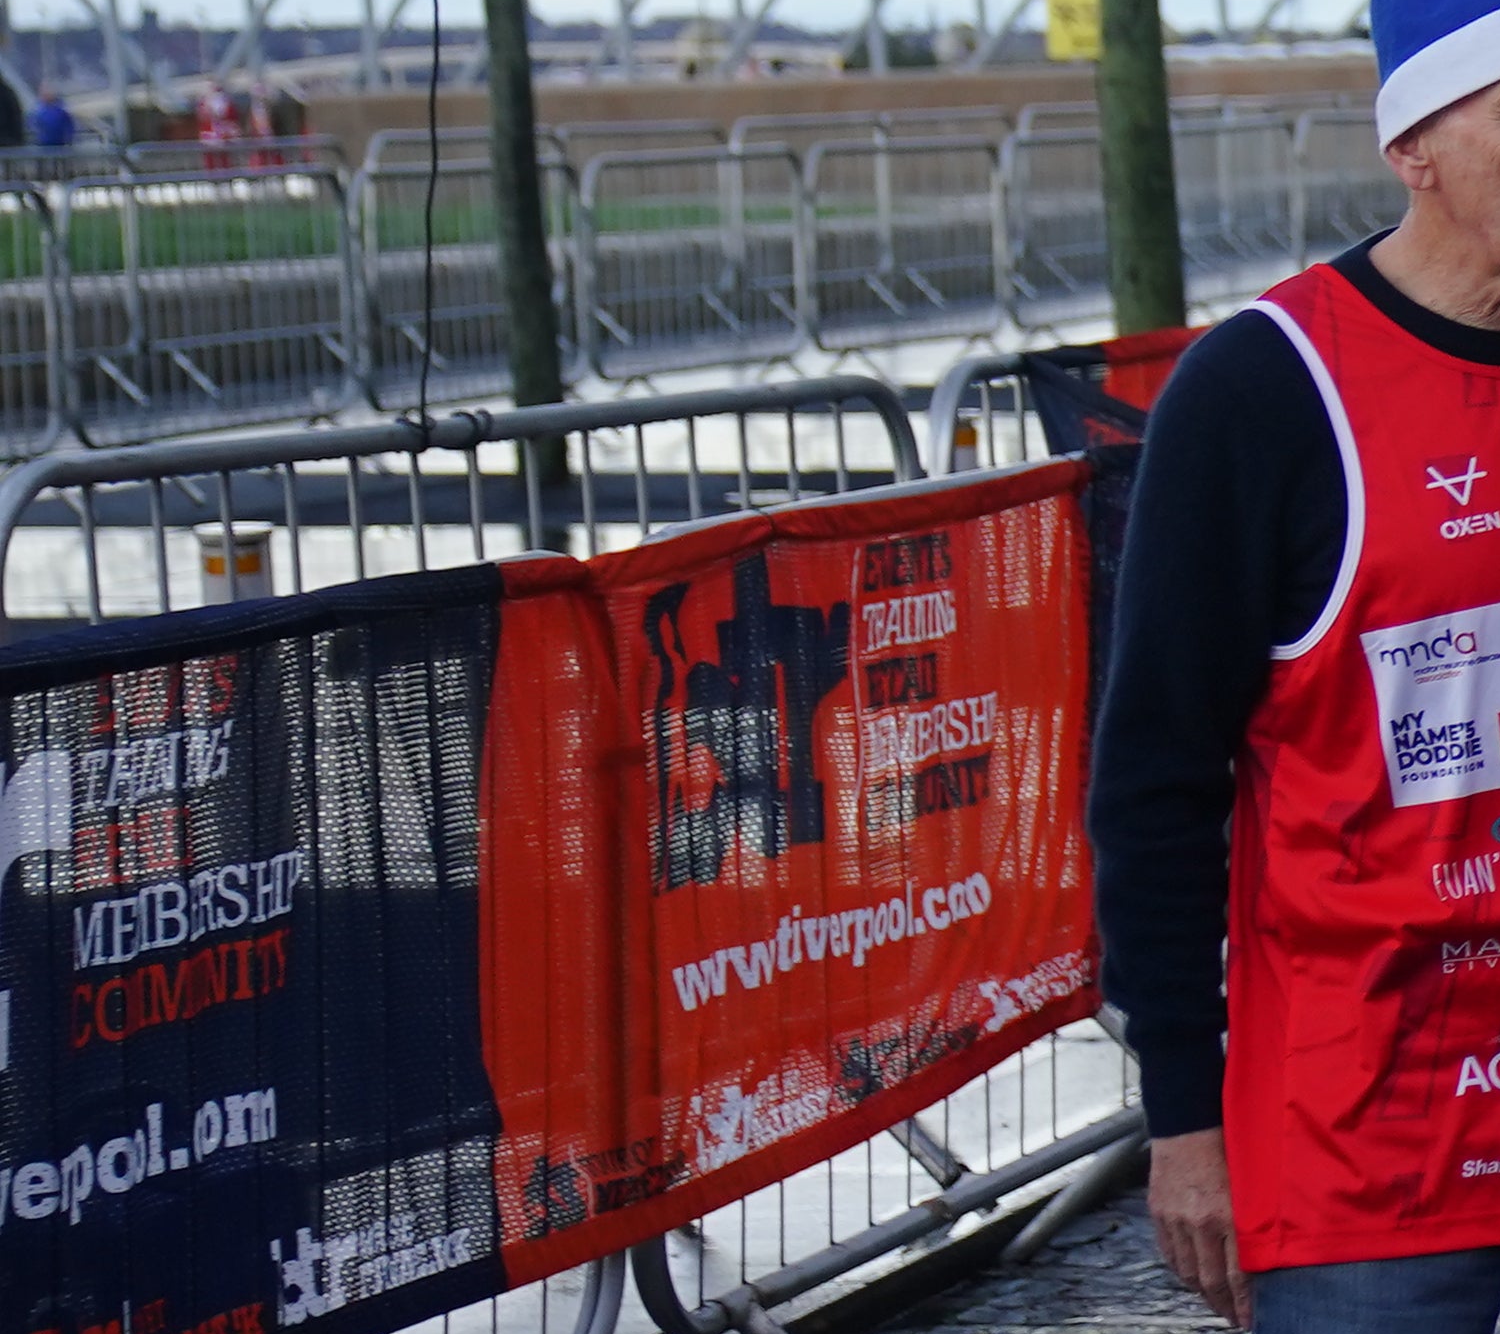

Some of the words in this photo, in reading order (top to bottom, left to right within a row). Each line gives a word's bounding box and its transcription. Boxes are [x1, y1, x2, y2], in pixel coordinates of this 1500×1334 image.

[1380, 628, 1478, 668] mnda
[1390, 710, 1426, 734] MY
[1395, 719, 1476, 752] NAME'S
[1398, 738, 1482, 771] DODDIE
